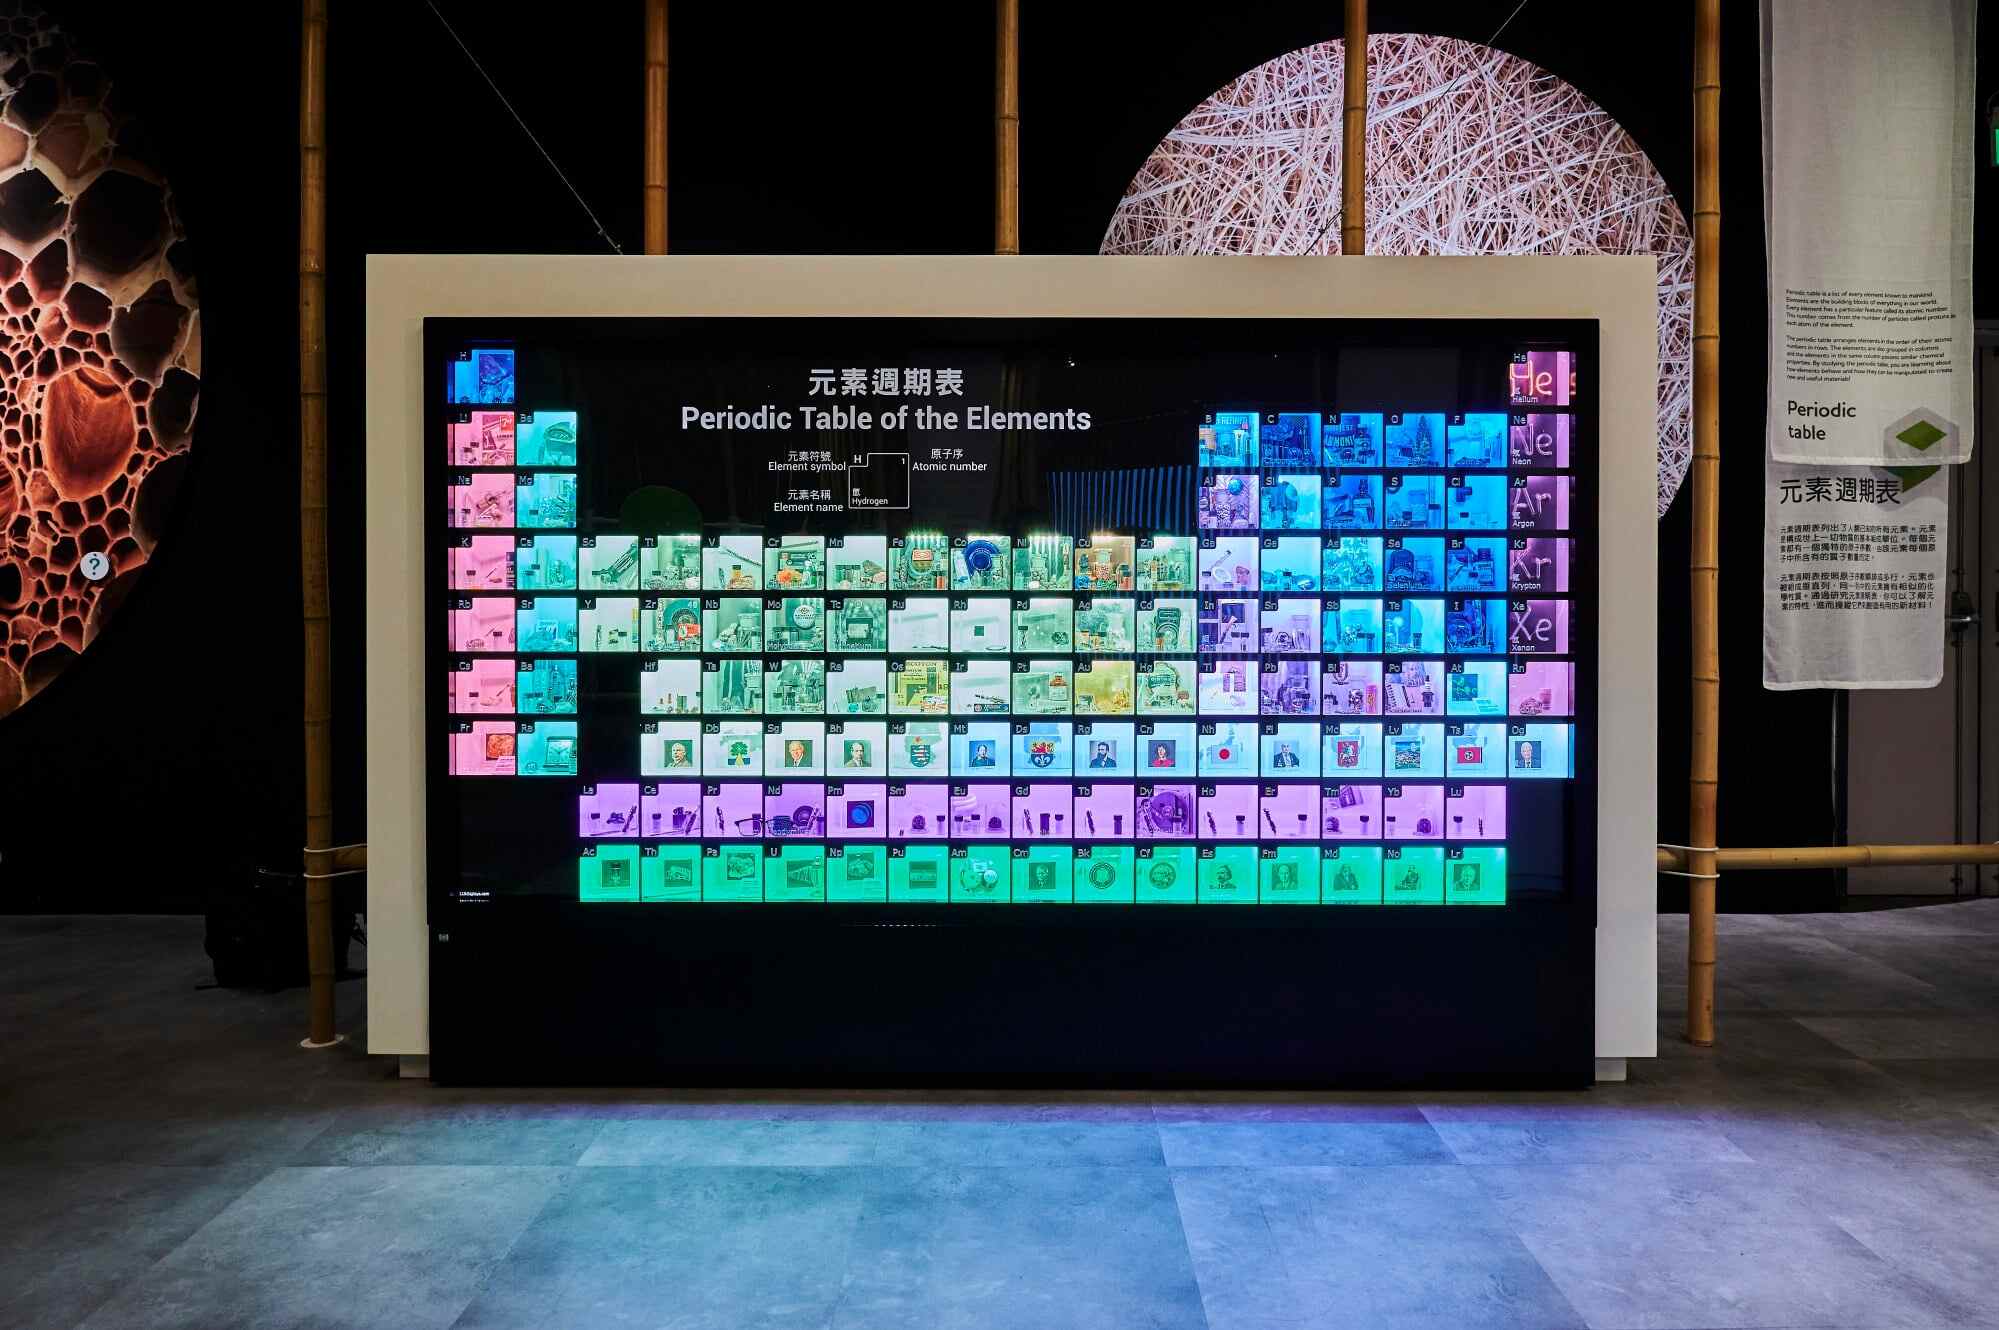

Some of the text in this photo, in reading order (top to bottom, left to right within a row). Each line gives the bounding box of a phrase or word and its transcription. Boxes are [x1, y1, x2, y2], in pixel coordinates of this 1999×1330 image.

[809, 368, 963, 396] 元素週期表
[1510, 360, 1552, 396] He
[1788, 401, 1856, 418] Periodic
[682, 405, 1091, 430] Periodic Table of the Elements
[1788, 425, 1826, 440] table
[1511, 423, 1552, 456] Ne
[788, 451, 831, 462] 元素符號
[931, 448, 963, 459] 原子序
[854, 456, 862, 464] H
[769, 461, 845, 472] Element symbol
[913, 461, 987, 471] Atomic number
[788, 490, 830, 500] 元素名稱
[1779, 476, 1901, 505] 元素週期表
[774, 502, 813, 511] Element
[852, 498, 888, 506] Hydrogen
[1512, 488, 1552, 518] Ar
[1512, 520, 1535, 528] Argon
[1512, 582, 1541, 591] Krypton
[1510, 605, 1552, 642] Xe
